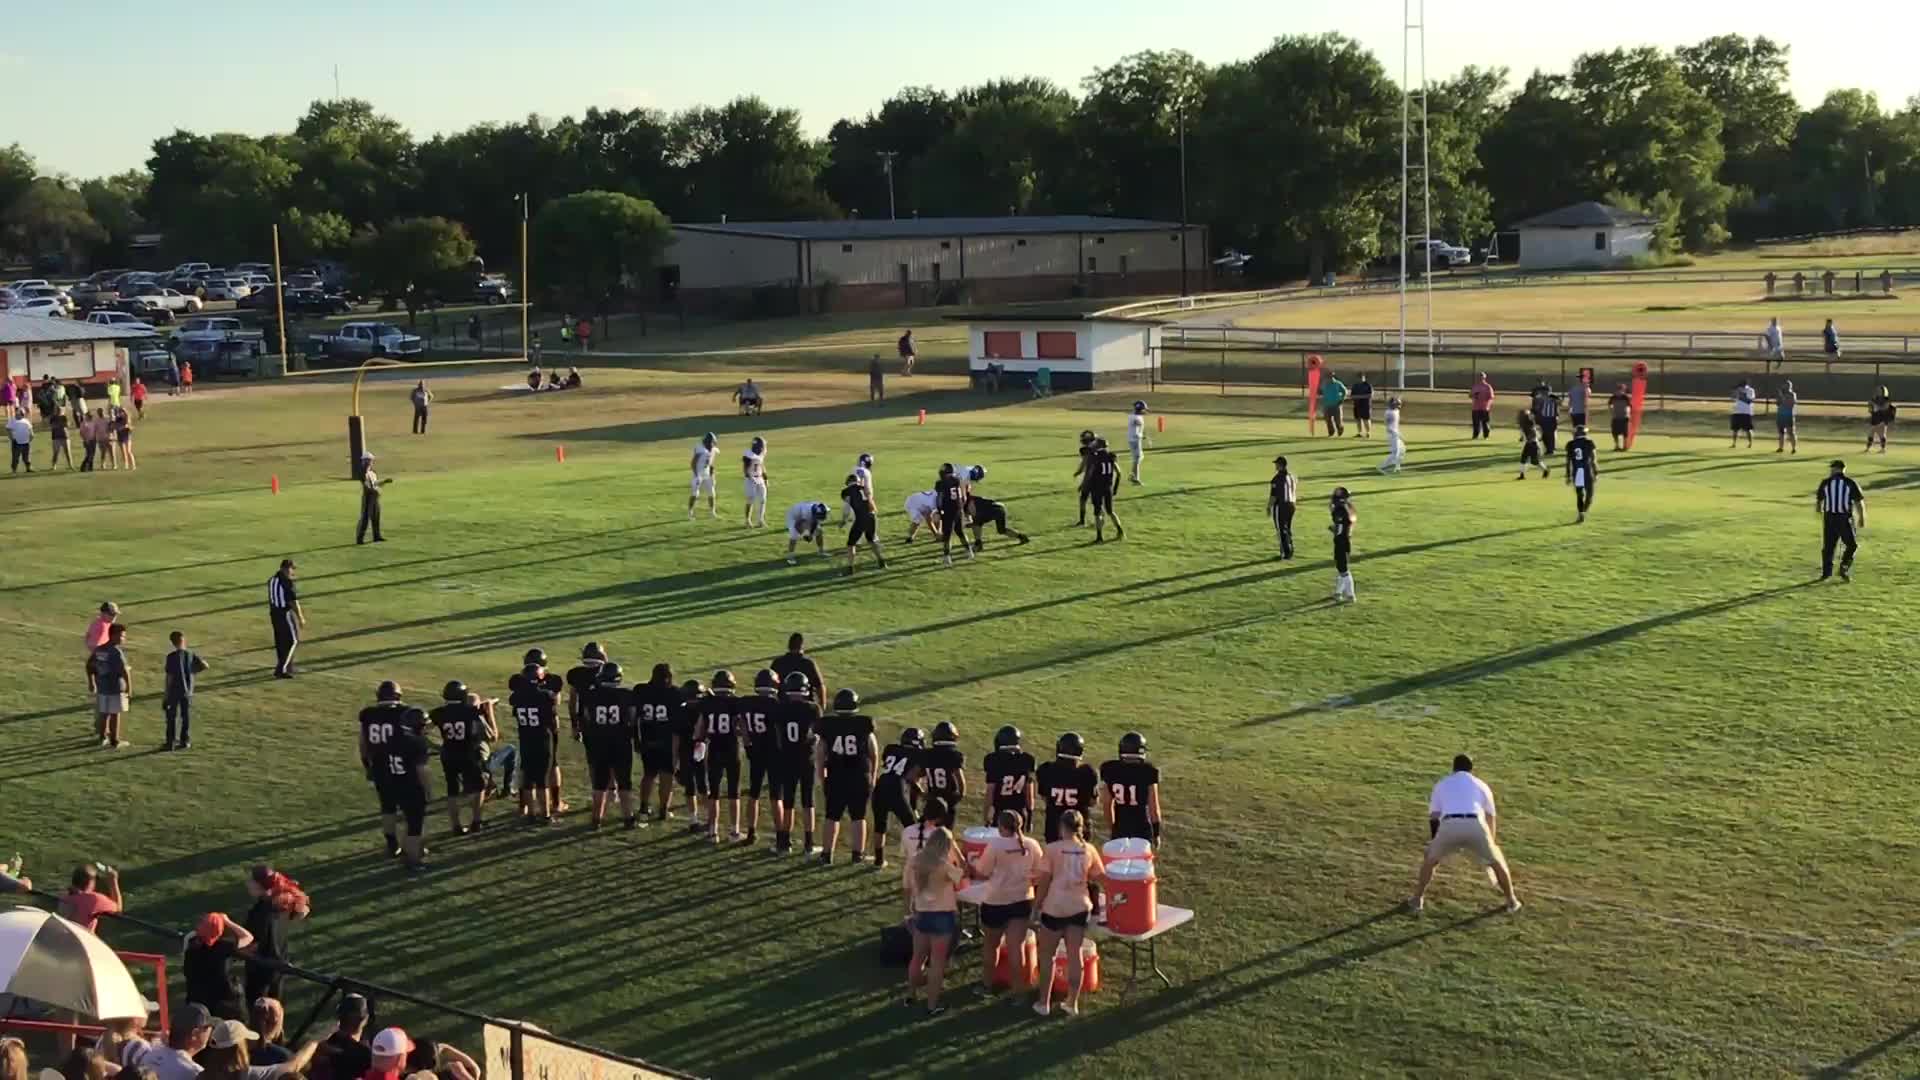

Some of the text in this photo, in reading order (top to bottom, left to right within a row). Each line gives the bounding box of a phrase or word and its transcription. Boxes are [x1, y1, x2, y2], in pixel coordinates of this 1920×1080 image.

[1574, 448, 1583, 460] 3
[517, 708, 539, 727] 55
[596, 704, 620, 725] 63
[643, 704, 668, 721] 32
[745, 712, 766, 733] 15
[443, 721, 465, 740] 33
[707, 713, 730, 734] 18
[787, 721, 800, 742] 0
[832, 734, 858, 755] 46
[1000, 774, 1026, 795] 24
[1051, 787, 1078, 806] 75
